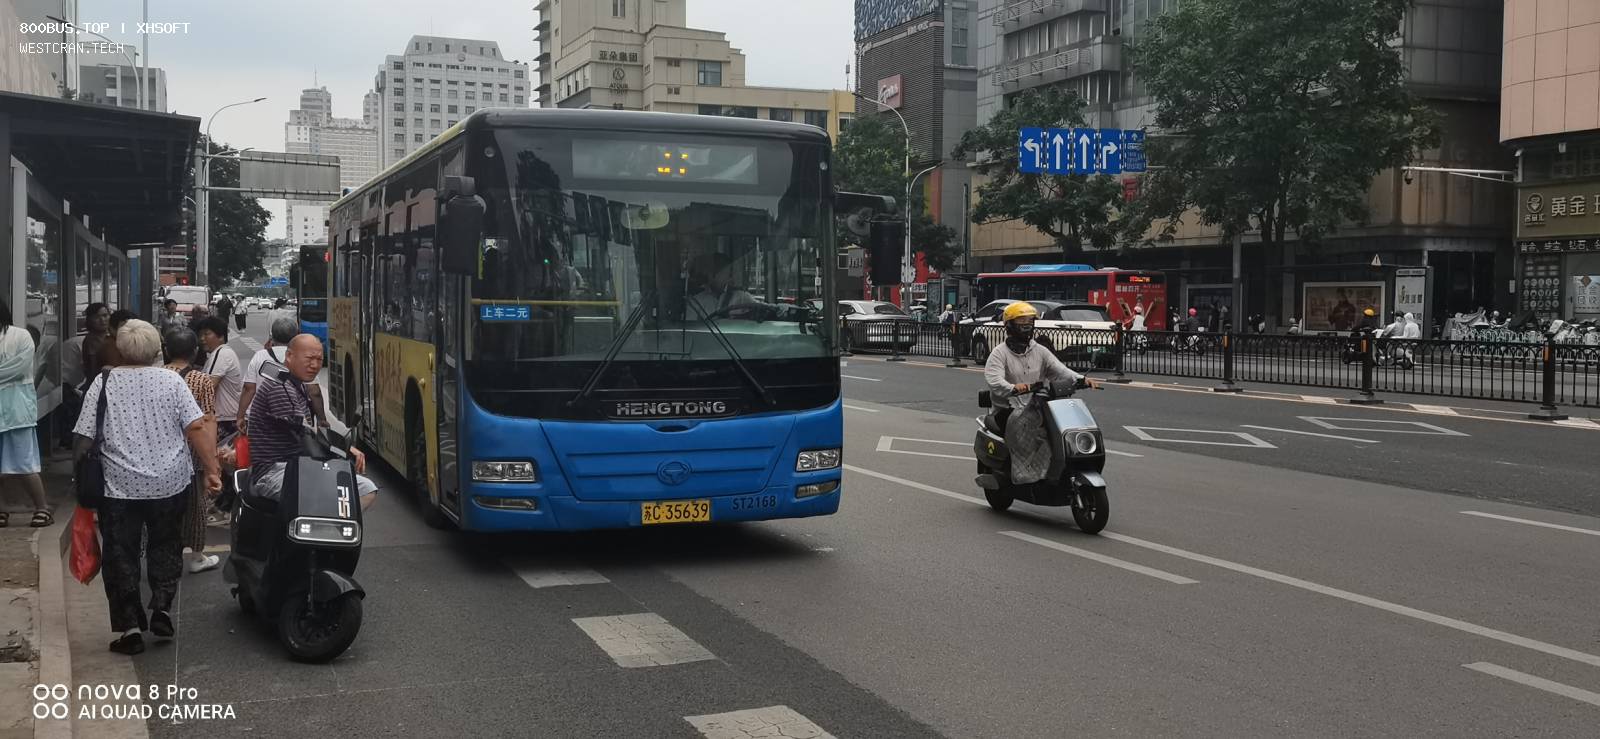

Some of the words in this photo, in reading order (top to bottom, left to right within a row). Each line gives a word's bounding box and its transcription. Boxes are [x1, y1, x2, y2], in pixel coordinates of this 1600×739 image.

[481, 307, 528, 318] 上车二元
[616, 401, 727, 416] HENGTONG
[732, 495, 777, 511] ST2168
